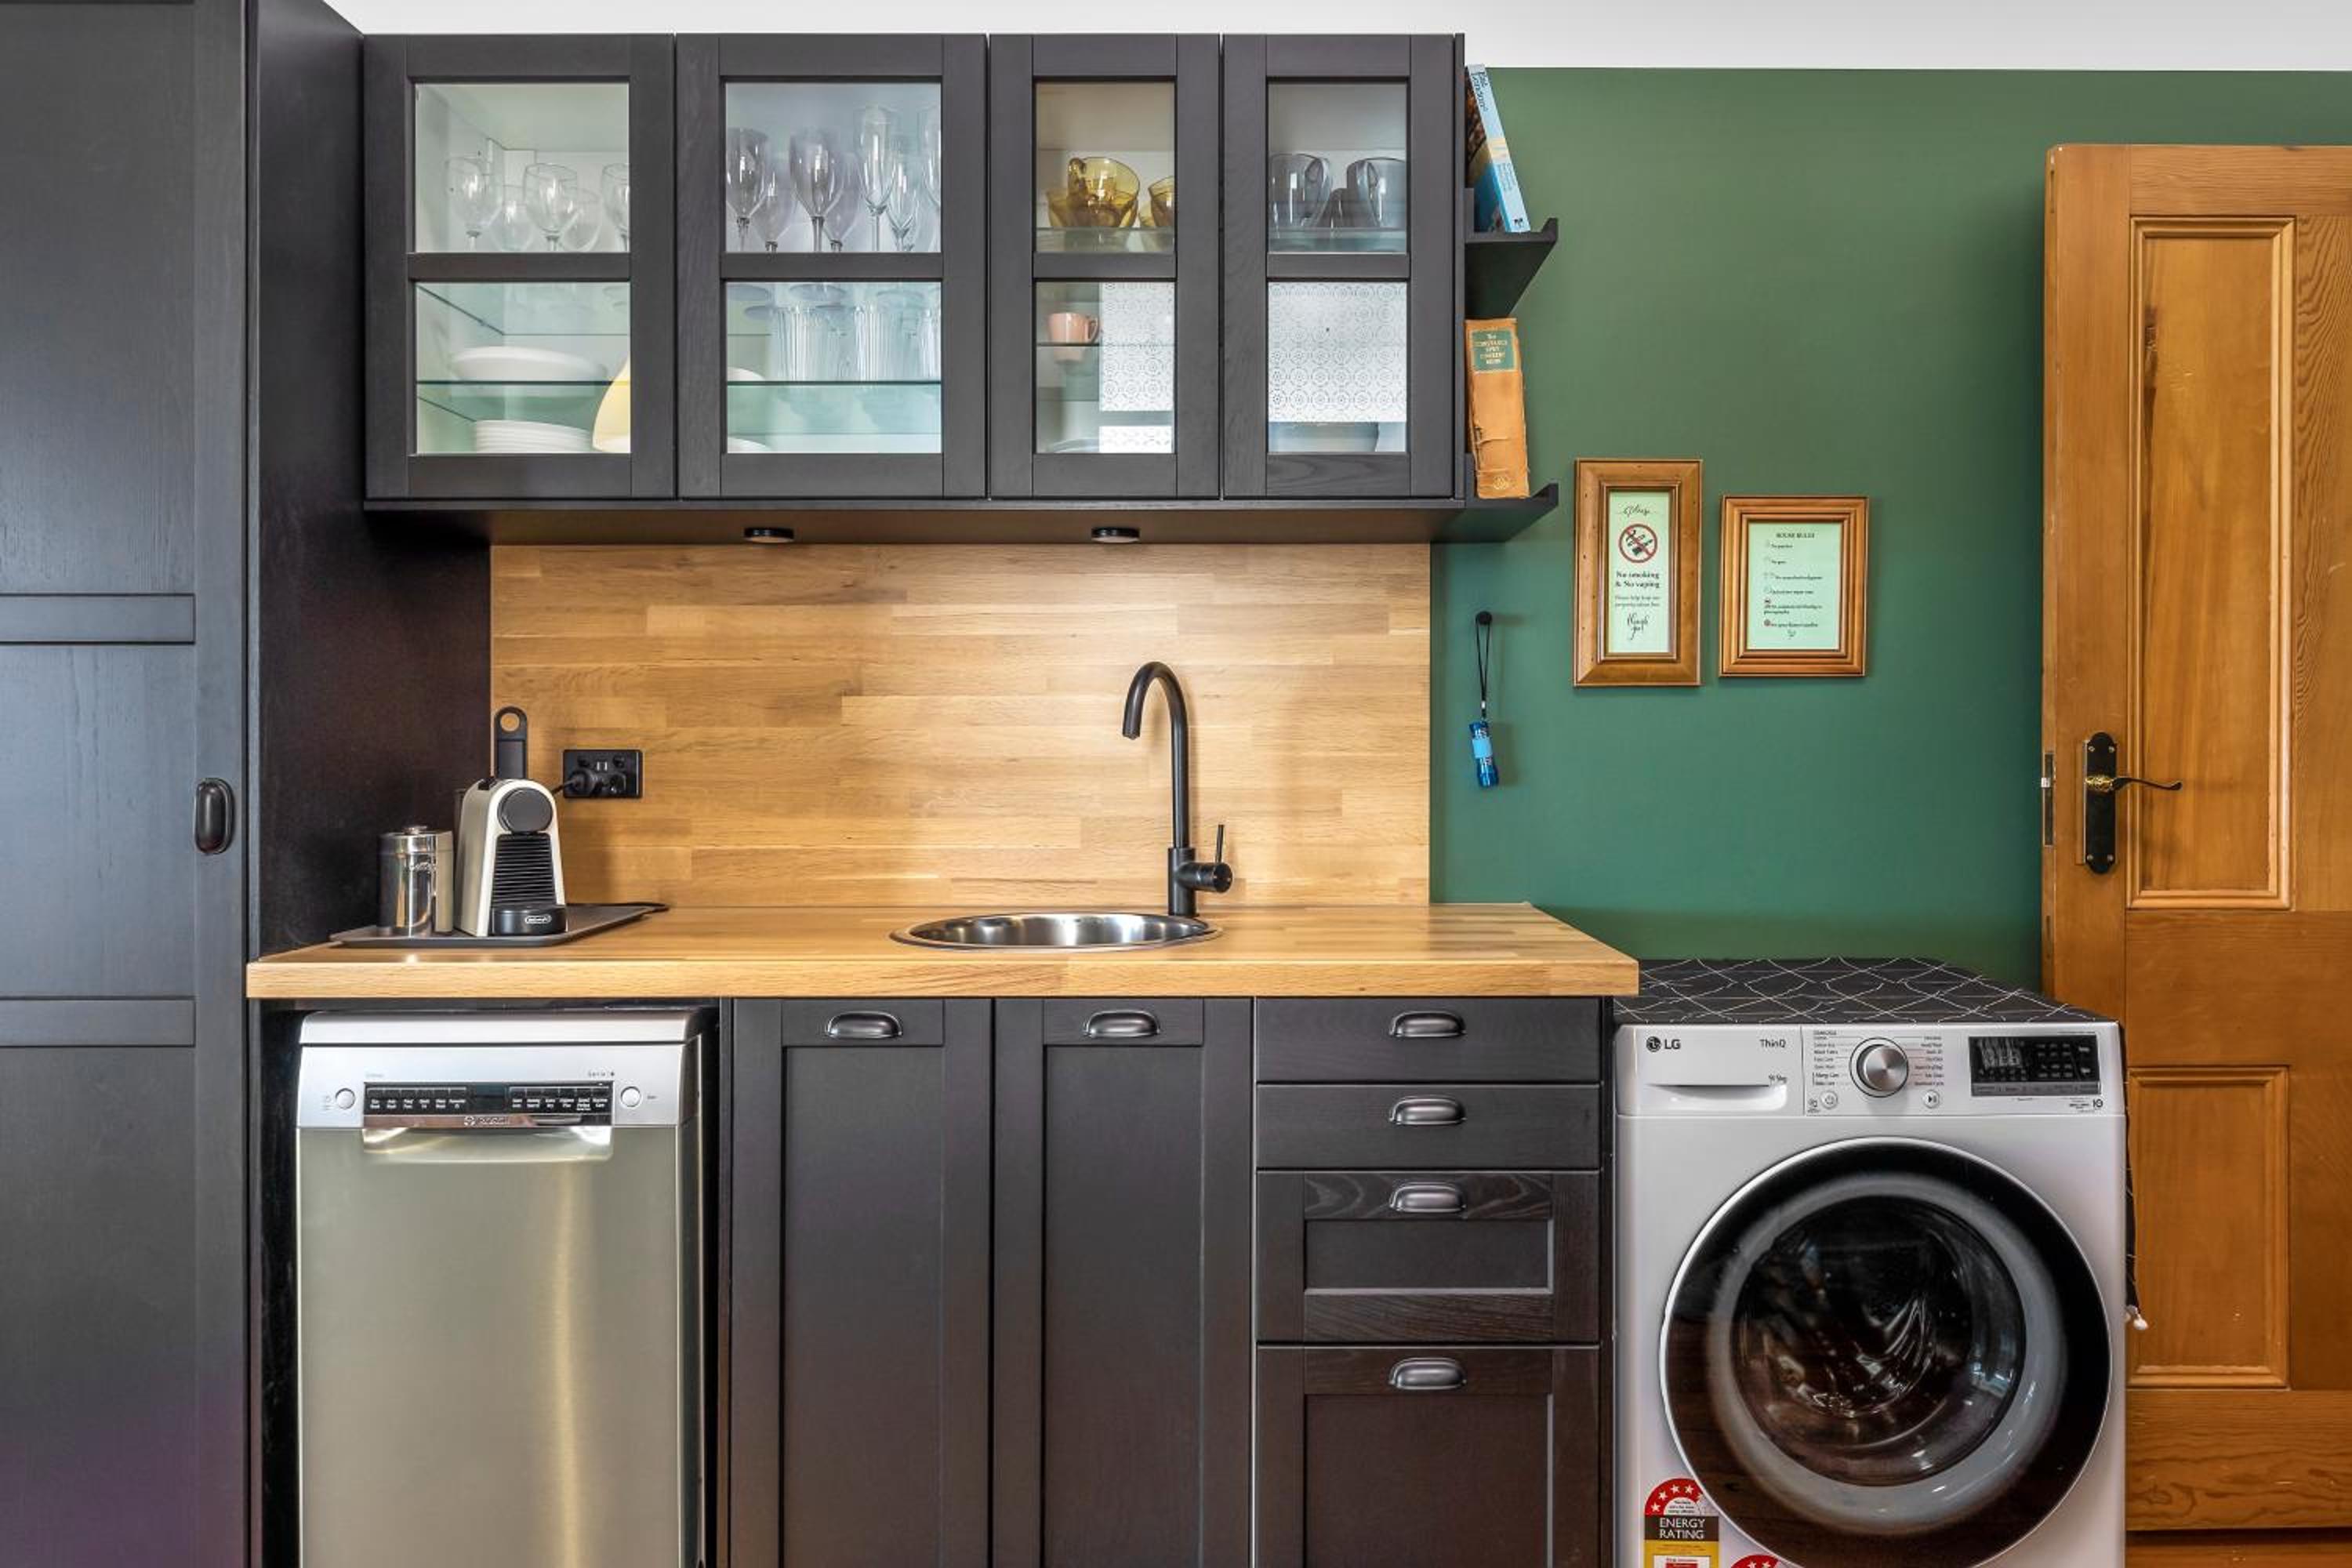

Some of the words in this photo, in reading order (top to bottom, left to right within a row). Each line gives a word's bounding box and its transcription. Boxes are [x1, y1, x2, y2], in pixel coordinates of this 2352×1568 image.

[1629, 570, 1660, 579] smoking
[1664, 1039, 1681, 1050] LG
[1759, 1039, 1787, 1048] ThinQ
[1660, 1518, 1705, 1528] ENERGY
[1660, 1530, 1704, 1539] RATING
